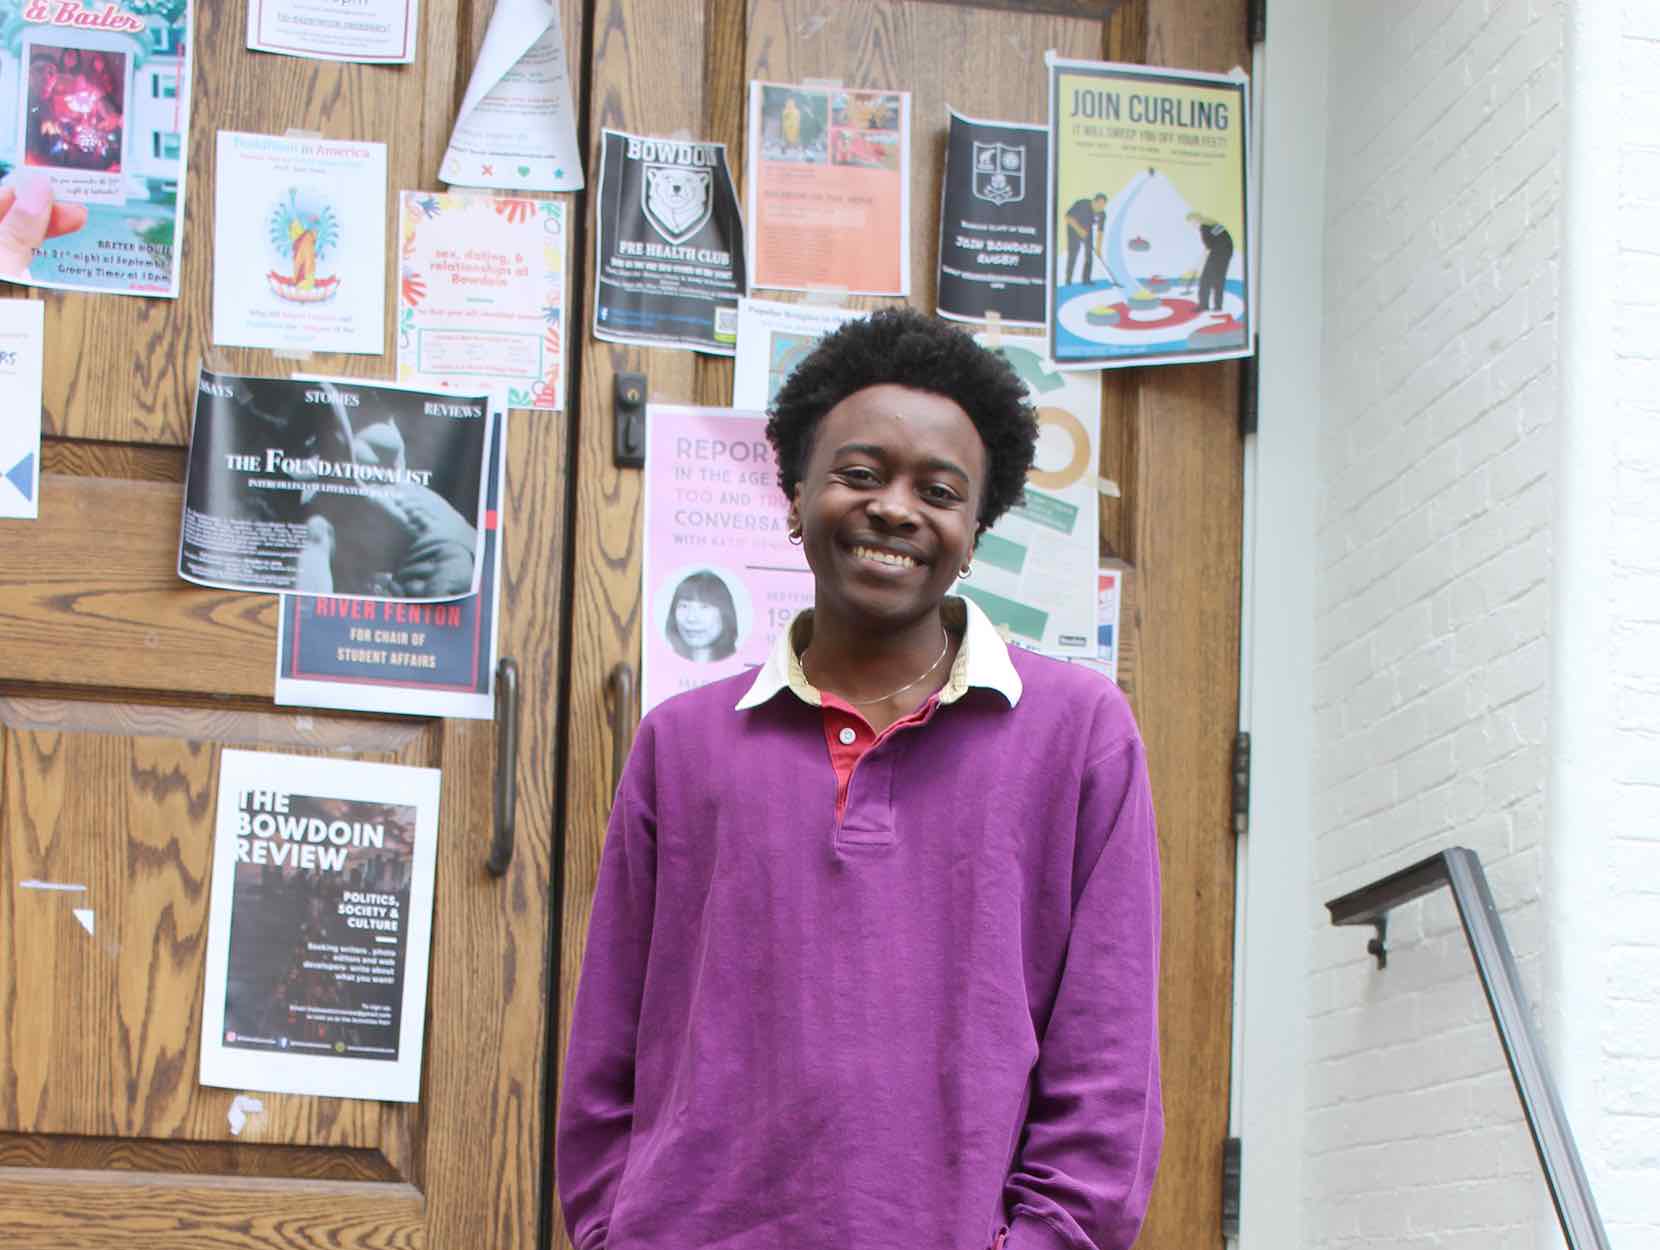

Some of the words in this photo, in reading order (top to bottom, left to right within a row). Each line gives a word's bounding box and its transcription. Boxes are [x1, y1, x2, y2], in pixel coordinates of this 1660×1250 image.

[1071, 89, 1120, 121] JOIN
[1129, 94, 1229, 131] CURLING
[1106, 127, 1137, 141] SWEEP
[1140, 130, 1157, 142] YOU
[1178, 132, 1199, 145] YOUR
[646, 242, 697, 262] HEALTH
[698, 249, 730, 266] CLUB
[430, 259, 512, 276] relationships
[424, 401, 482, 418] REVIEWS
[677, 436, 769, 463] REPOR
[225, 453, 261, 473] THE
[674, 466, 690, 482] IN
[700, 467, 731, 483] THE
[738, 471, 769, 487] AGE
[674, 487, 713, 502] TOO
[720, 492, 752, 507] AND
[316, 597, 377, 621] RIVER
[383, 601, 462, 627] FENTON
[351, 627, 371, 642] FOR
[374, 629, 409, 646] CHAIR
[411, 632, 427, 647] OF
[336, 647, 387, 665] STUDENT
[389, 652, 437, 670] AFFAIRS
[237, 788, 290, 814] THE
[236, 812, 385, 849] BOWDOIN
[232, 838, 349, 872] REVIEW
[342, 890, 400, 908] POLITICS,
[337, 903, 387, 918] SOCIETY
[389, 907, 399, 919] &
[346, 917, 398, 932] CULTURE
